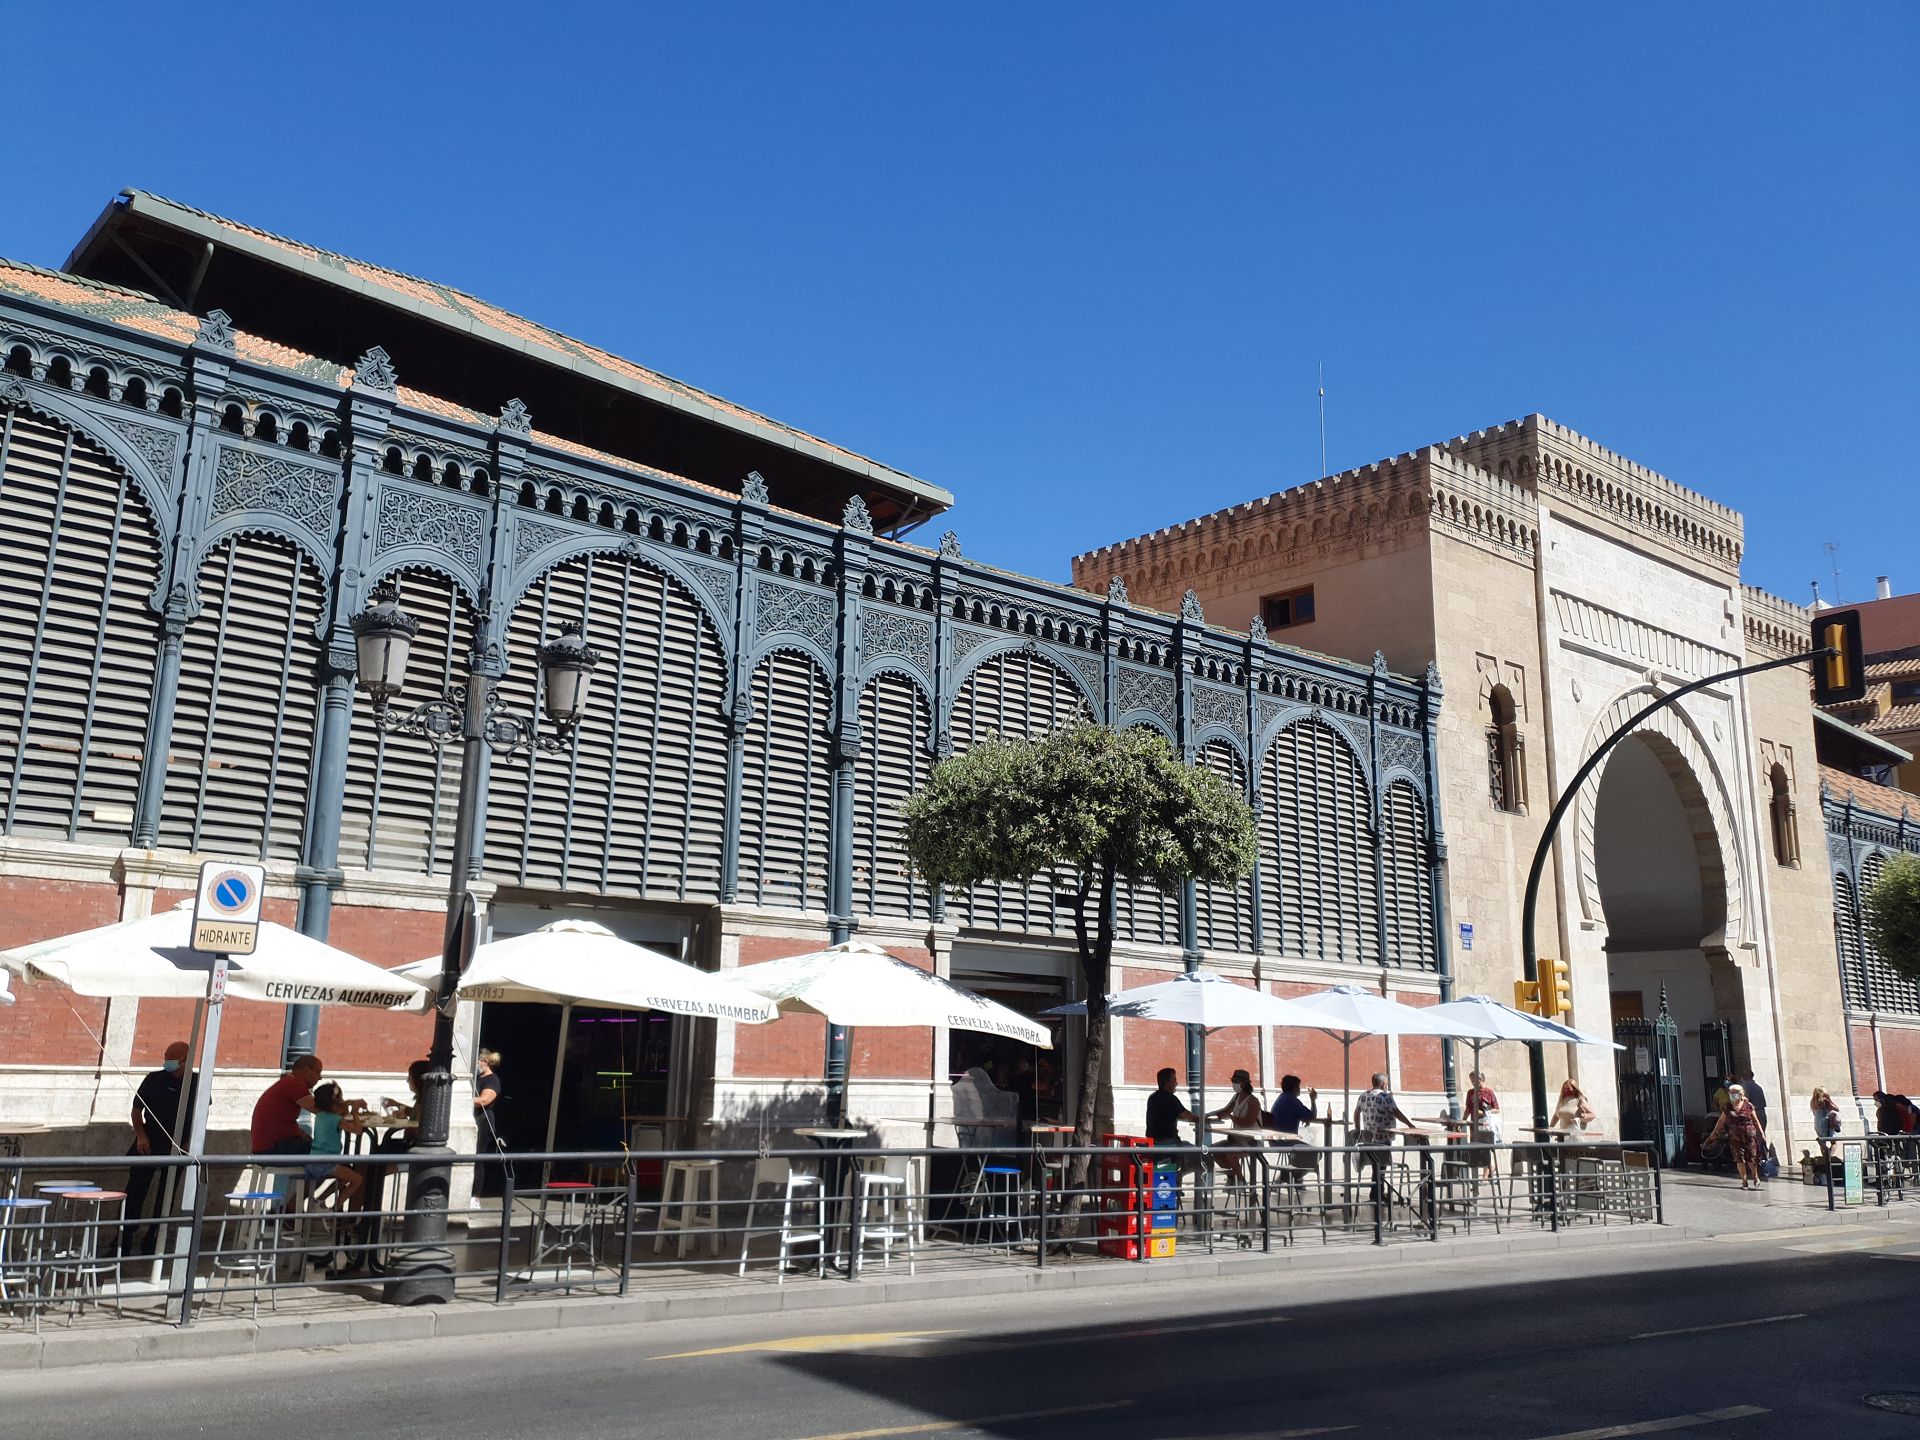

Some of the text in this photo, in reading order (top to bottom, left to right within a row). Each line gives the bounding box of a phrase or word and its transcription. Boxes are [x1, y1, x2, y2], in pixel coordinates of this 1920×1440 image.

[199, 928, 251, 945] HIDRANTE
[265, 982, 335, 1001] CERVEZAS
[646, 996, 768, 1021] CERVEZAS ALHAMBRA
[947, 1015, 1042, 1043] CERVEZAS ALHAMBRA
